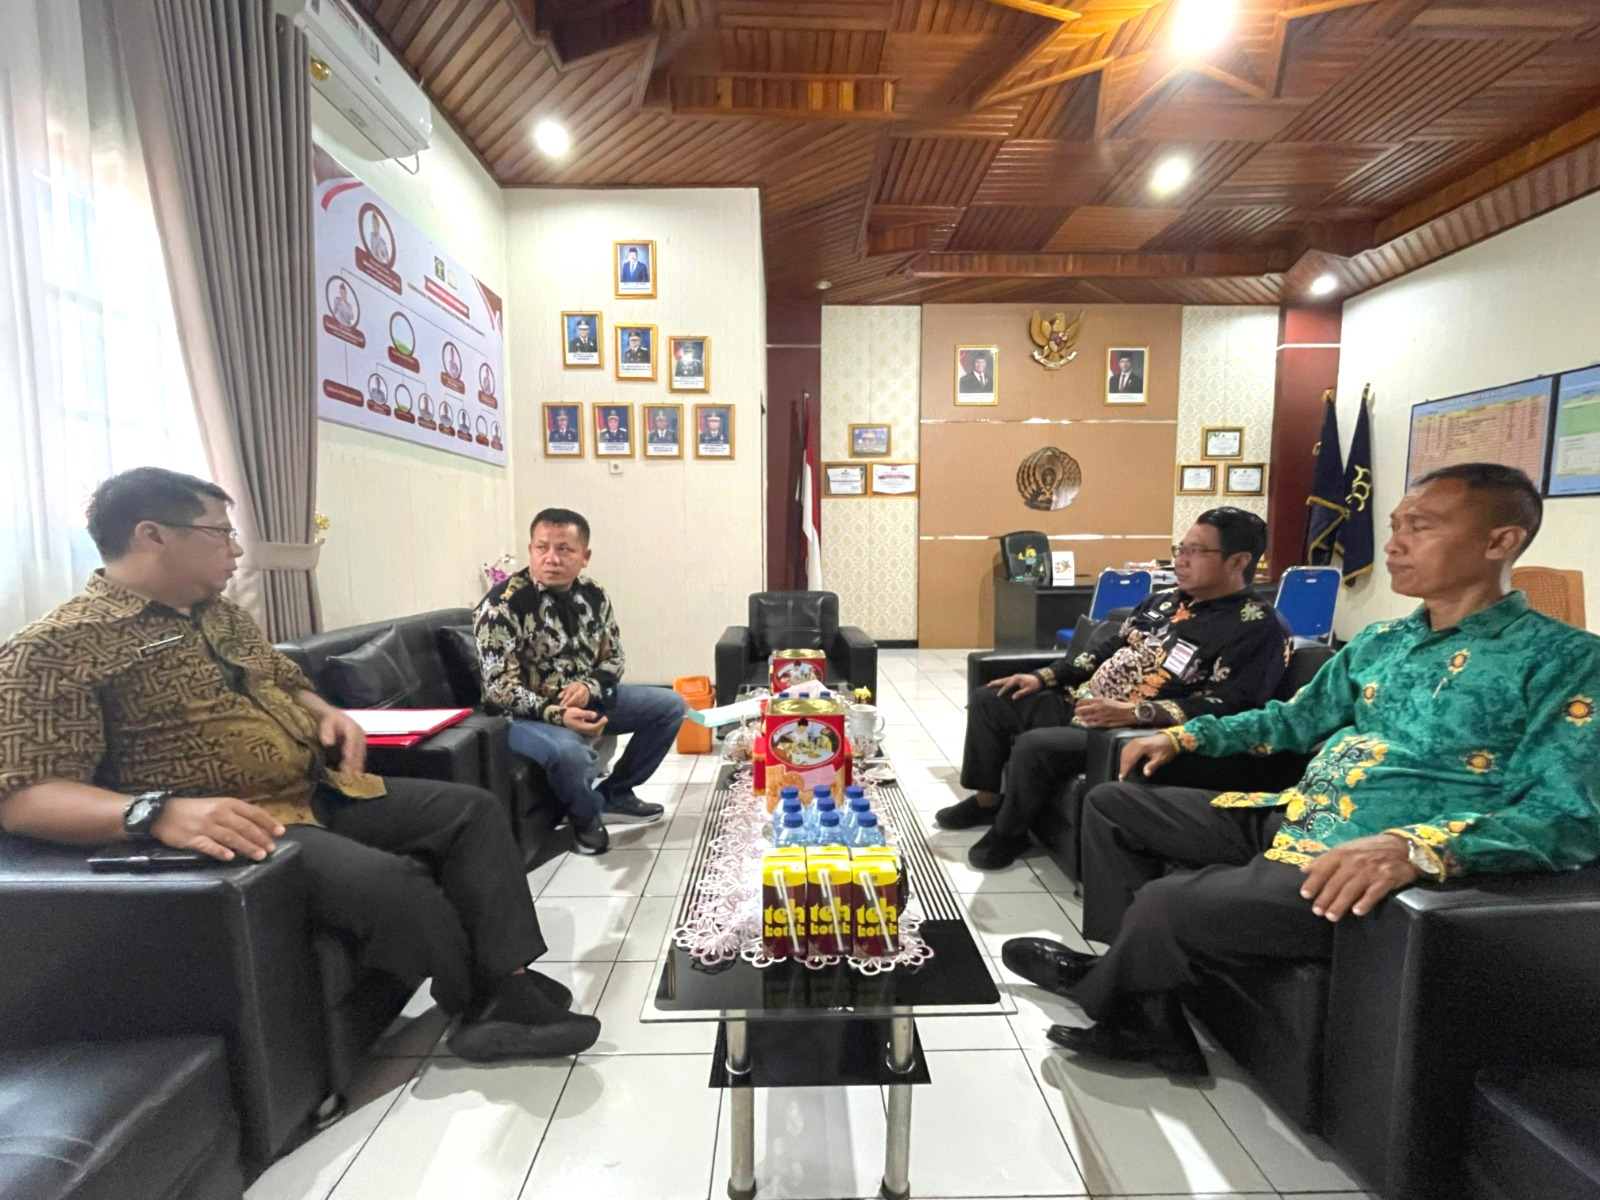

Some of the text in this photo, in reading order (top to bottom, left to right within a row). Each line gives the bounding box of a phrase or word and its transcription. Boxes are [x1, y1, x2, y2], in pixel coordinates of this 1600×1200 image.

[764, 898, 805, 924] teh
[810, 896, 851, 922] teh
[856, 897, 897, 924] teh
[764, 924, 805, 937] kotk
[810, 921, 851, 935] kotk
[857, 922, 897, 937] kotk
